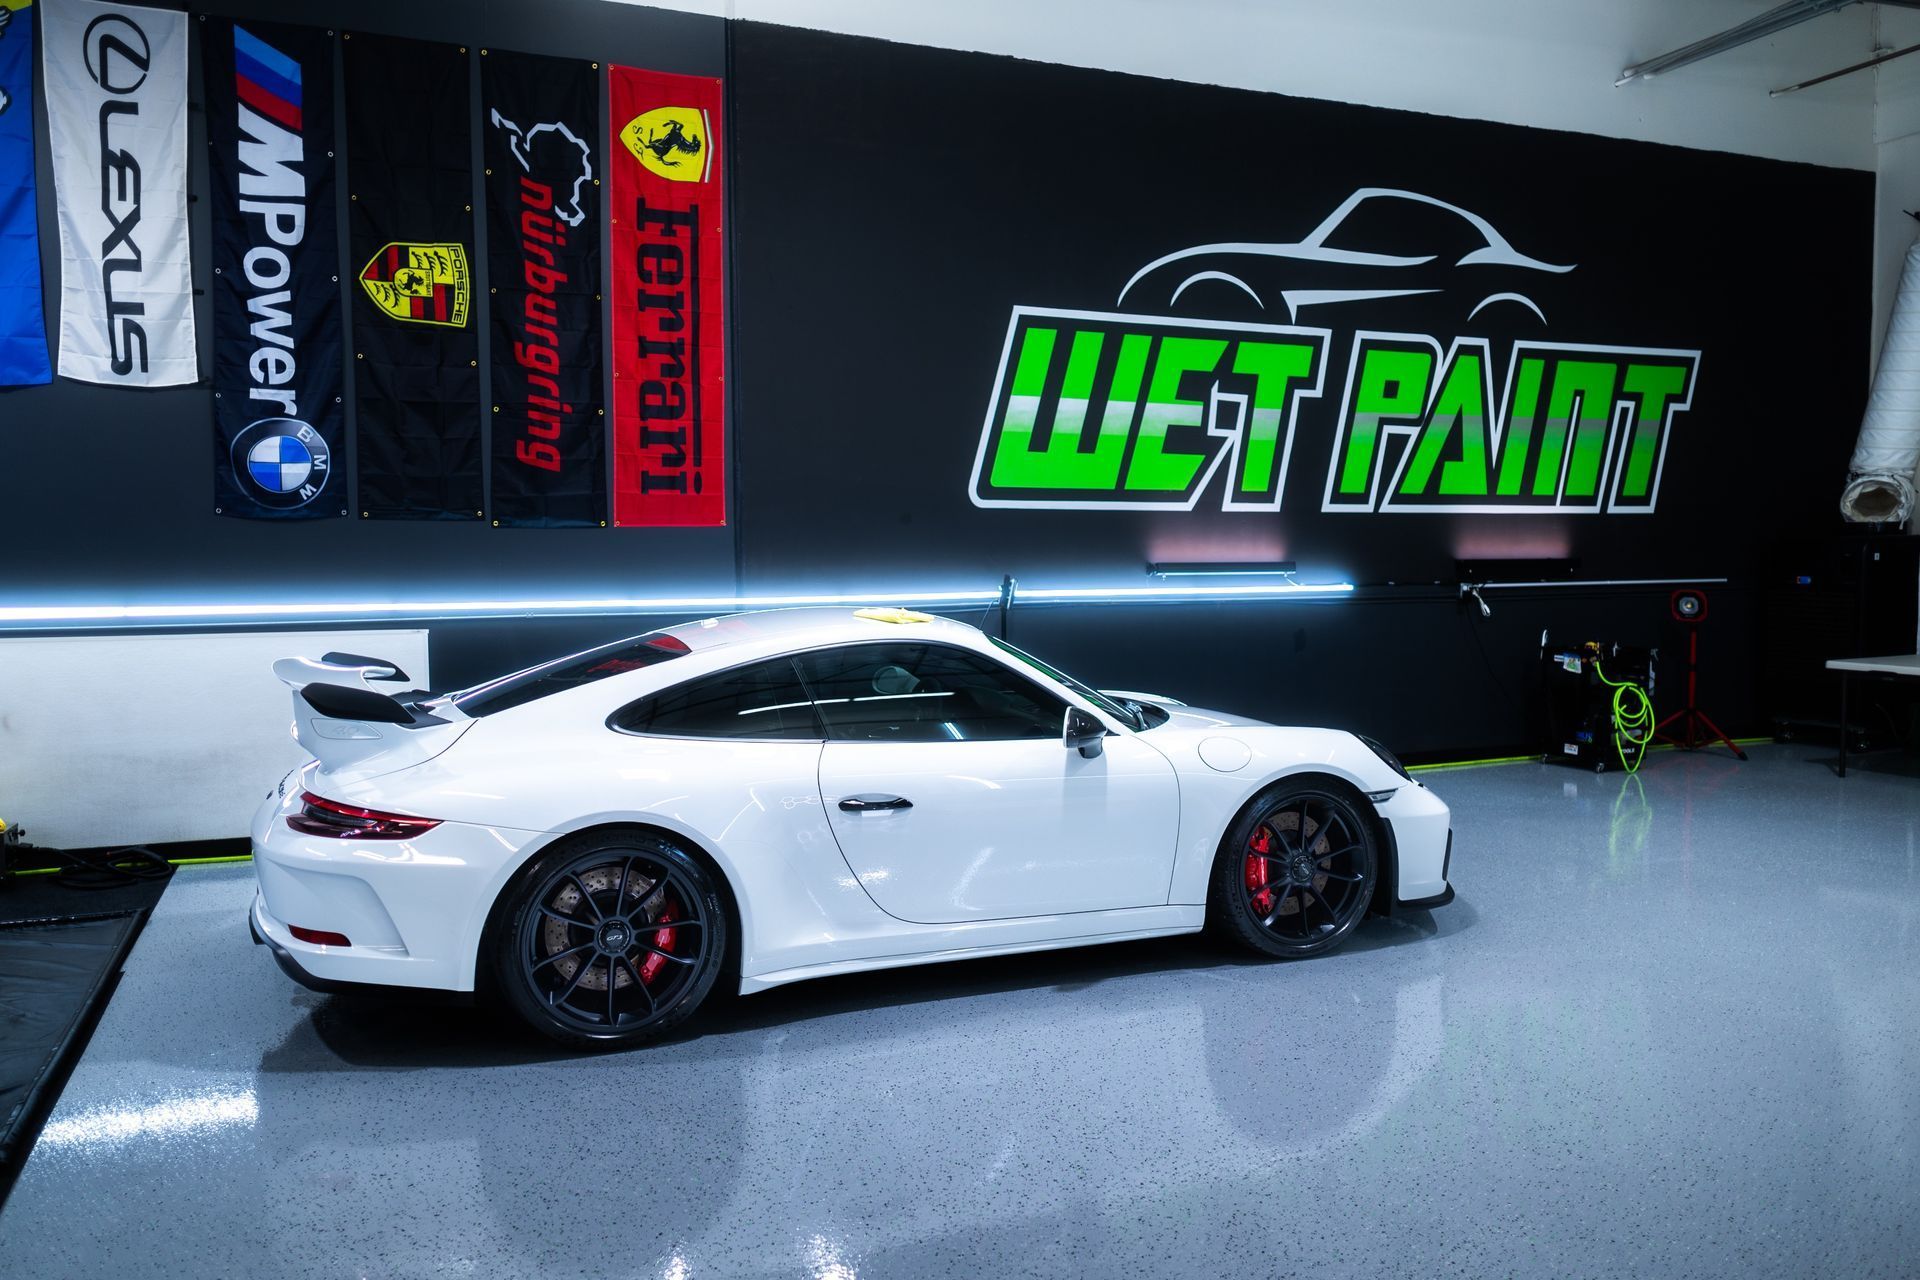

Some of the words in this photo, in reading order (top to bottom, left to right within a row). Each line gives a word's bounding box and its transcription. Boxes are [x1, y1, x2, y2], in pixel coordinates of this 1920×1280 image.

[99, 101, 149, 377] LEXUS
[450, 248, 465, 323] PORSCHE
[514, 176, 572, 472] nürburgring
[636, 197, 702, 495] Ferrari
[990, 326, 1314, 492] WET
[1339, 349, 1688, 497] PAINT
